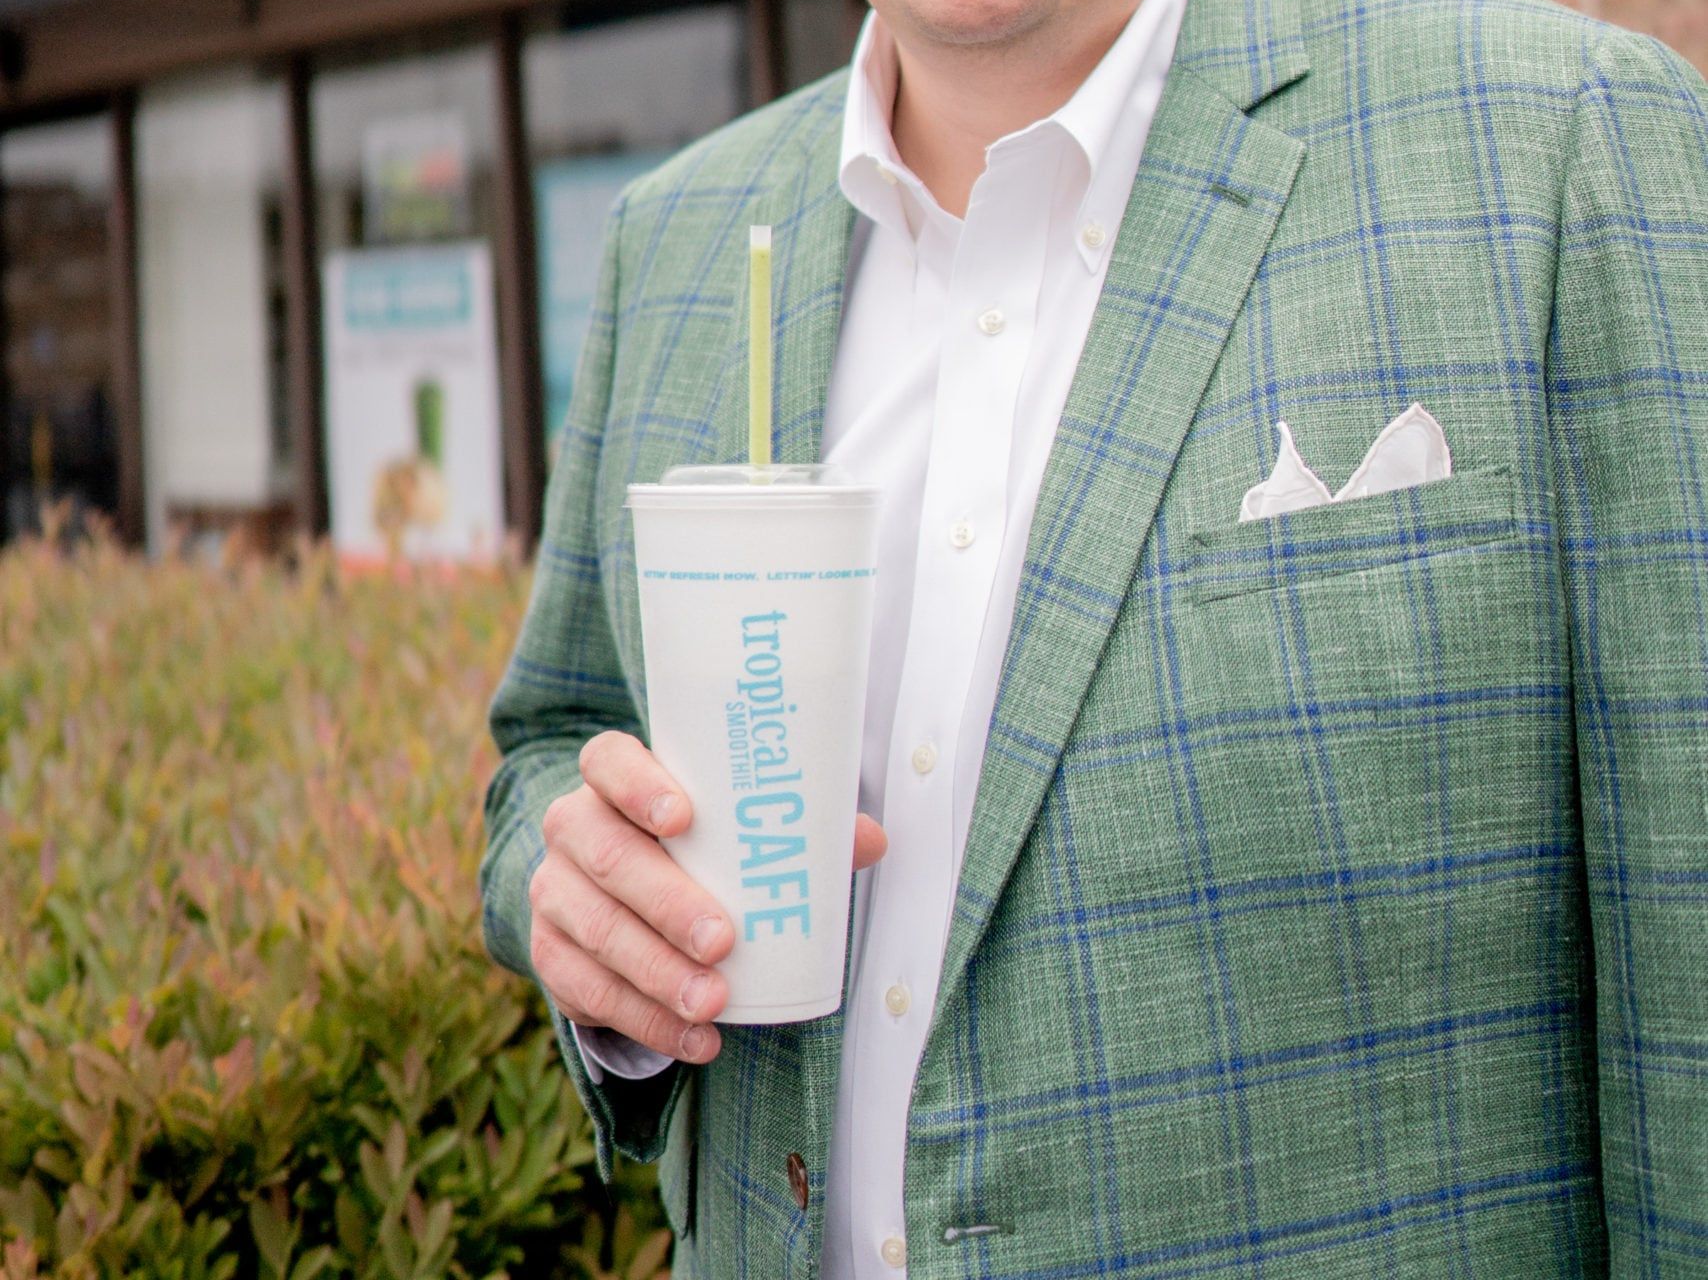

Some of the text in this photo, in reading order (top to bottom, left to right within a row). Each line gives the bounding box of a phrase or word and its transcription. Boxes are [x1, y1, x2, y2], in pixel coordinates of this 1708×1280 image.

[725, 700, 753, 791] SMOOTHIE
[735, 609, 803, 790] tropical
[734, 791, 812, 942] CAFE
